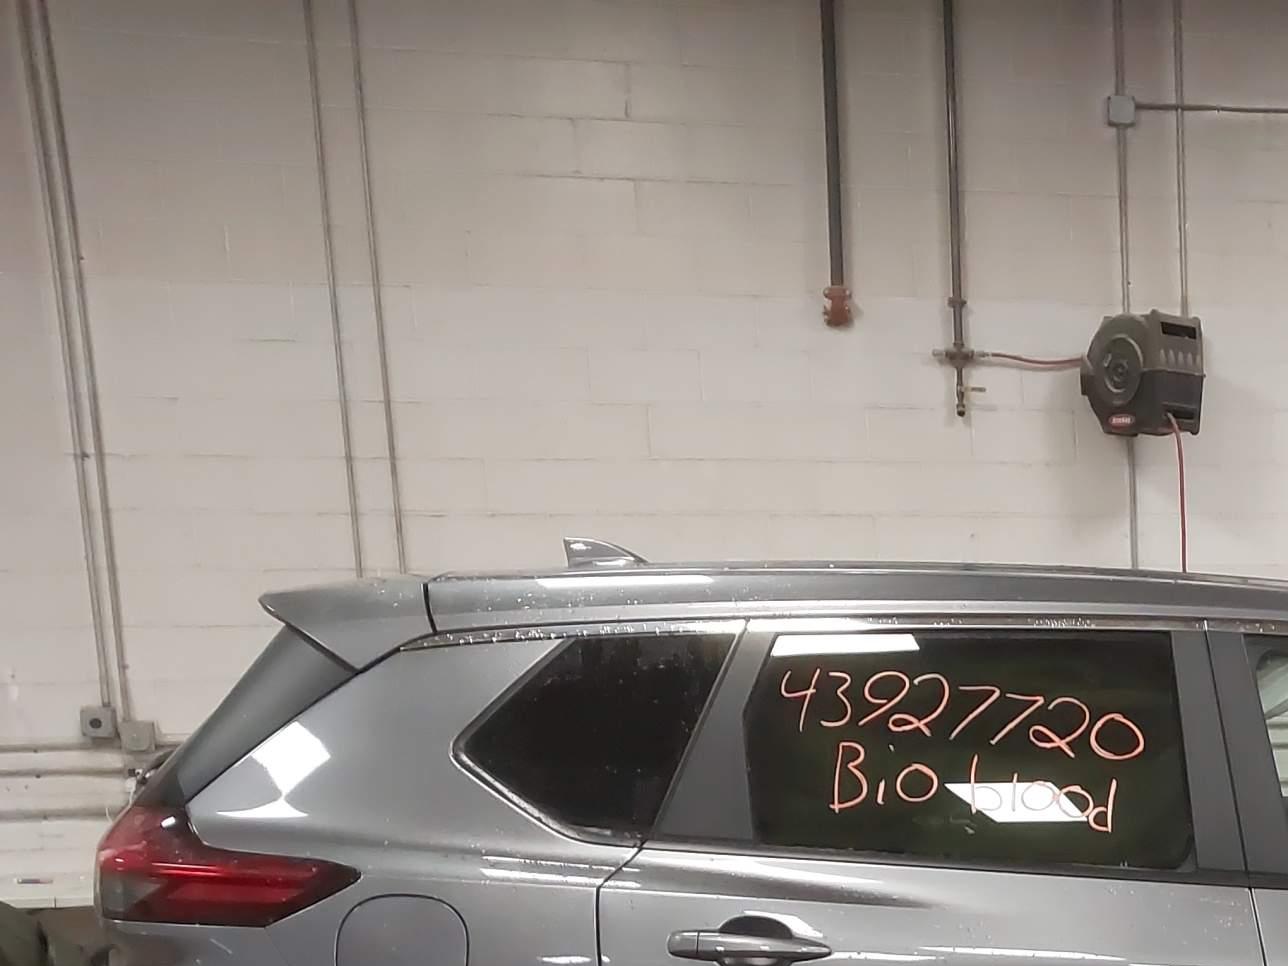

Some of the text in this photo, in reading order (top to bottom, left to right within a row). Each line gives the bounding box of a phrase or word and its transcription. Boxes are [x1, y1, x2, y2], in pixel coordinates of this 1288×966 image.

[781, 668, 1145, 760] 43927720
[829, 742, 1117, 832] Bio blood
